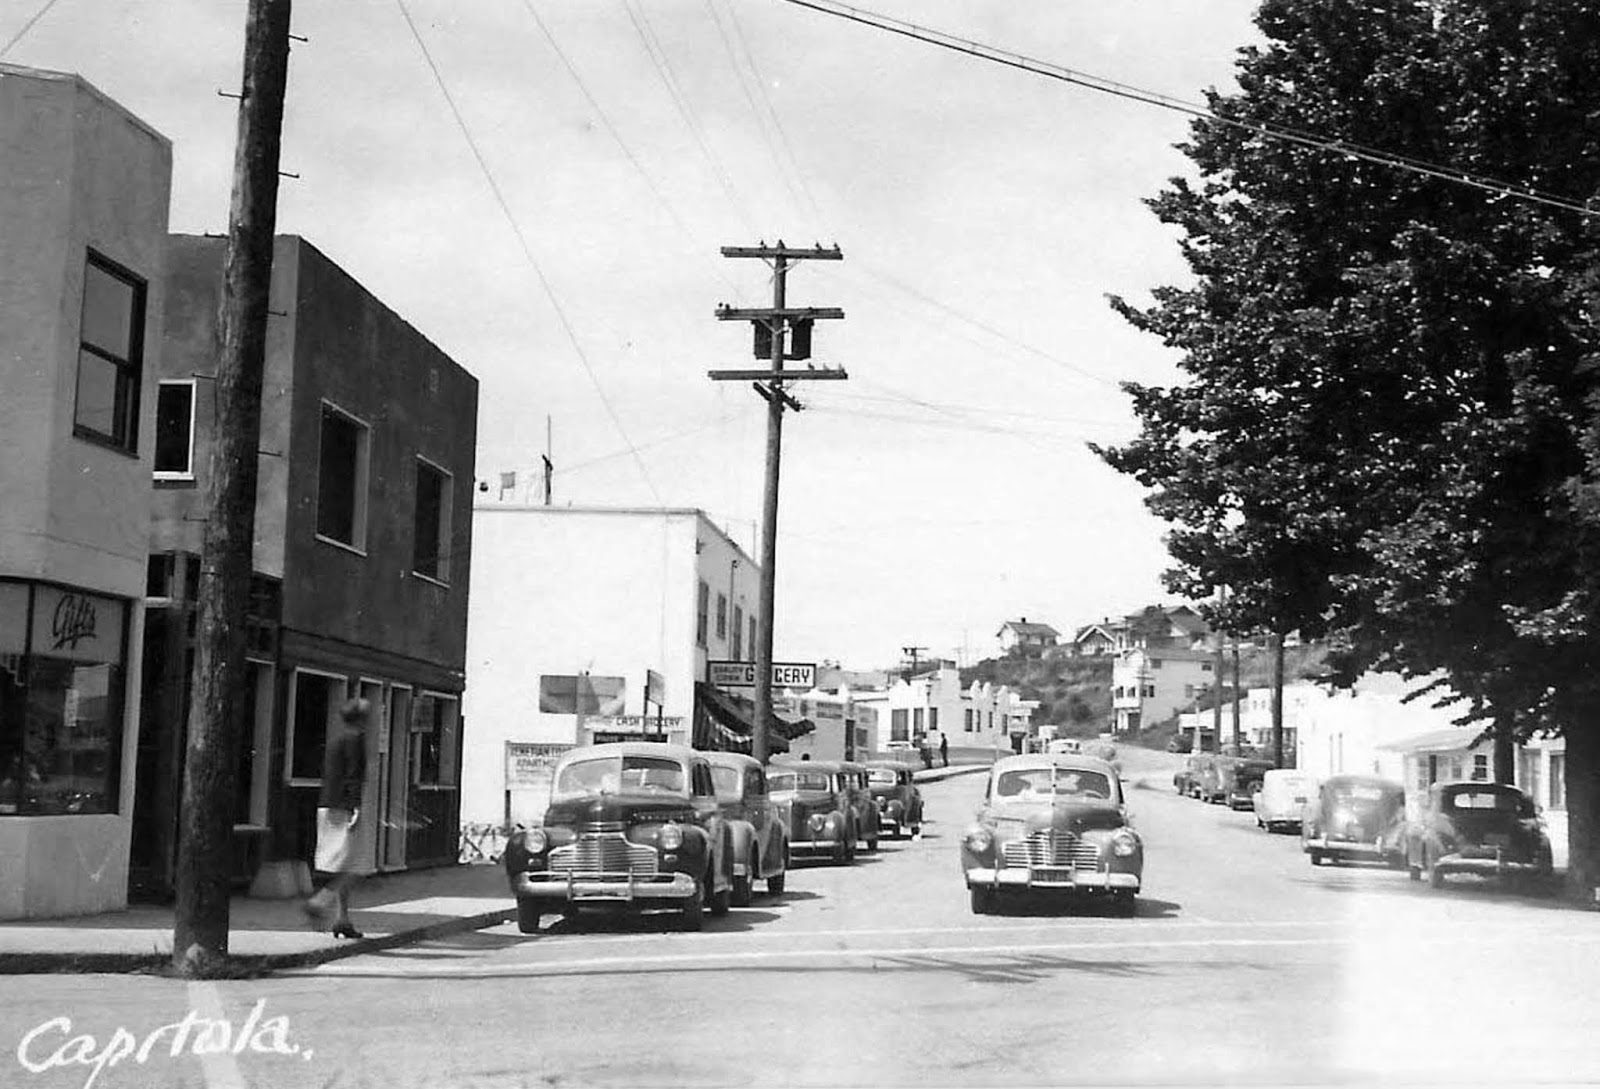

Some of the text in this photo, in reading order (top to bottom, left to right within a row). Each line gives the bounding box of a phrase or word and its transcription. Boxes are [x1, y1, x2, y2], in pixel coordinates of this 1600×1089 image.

[52, 594, 97, 650] Gifts
[745, 667, 810, 684] GCERY
[617, 715, 640, 726] CASH
